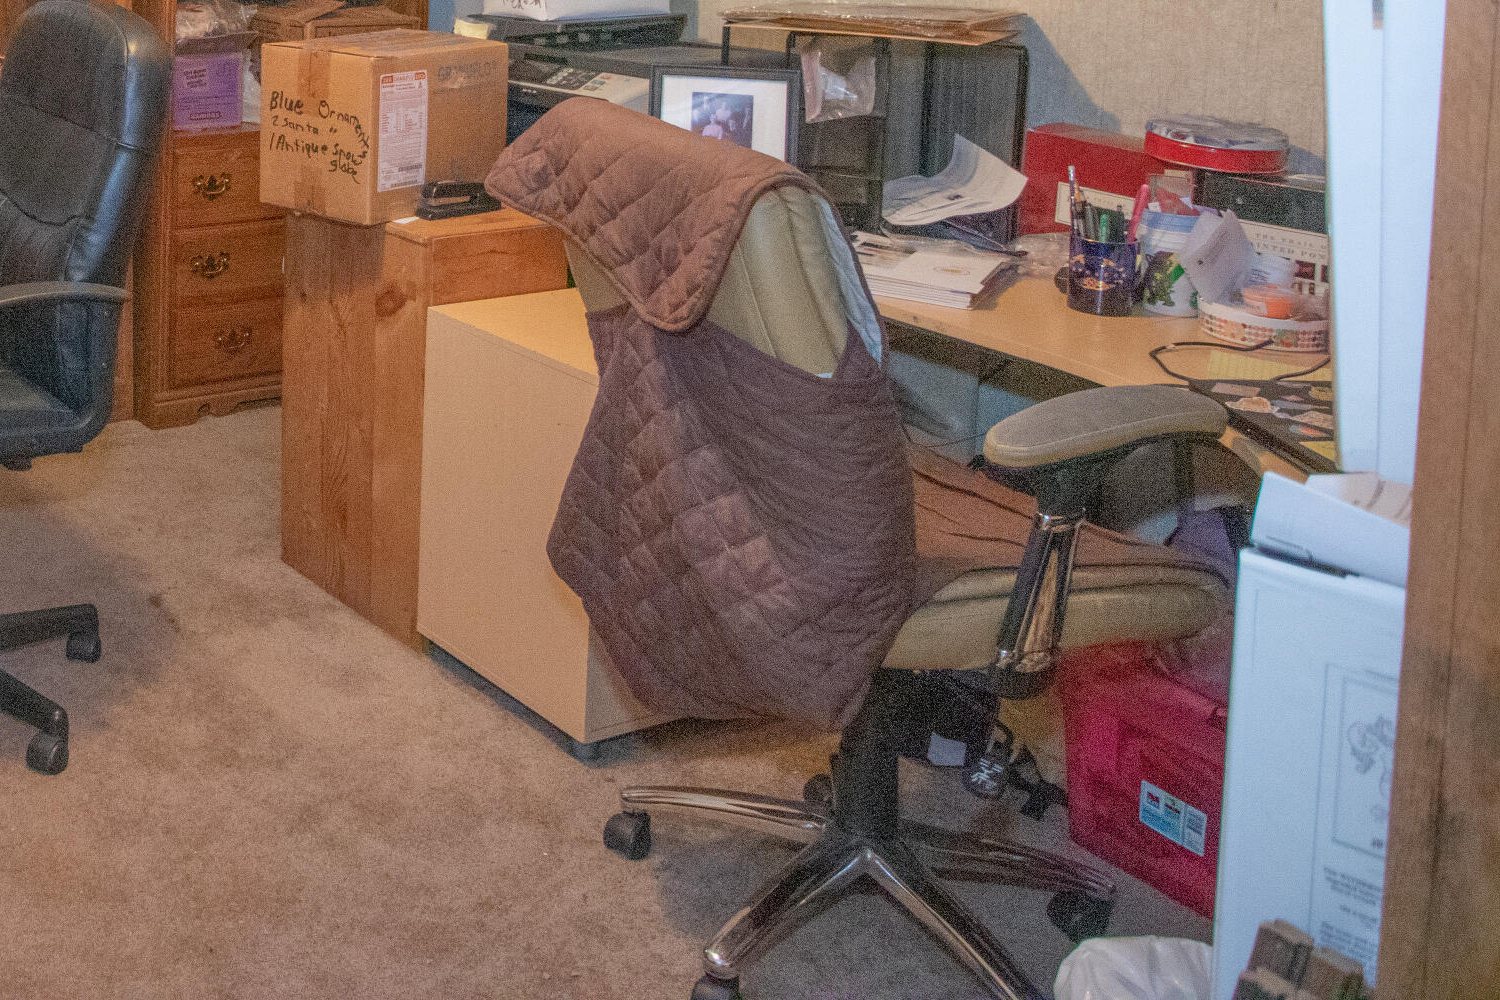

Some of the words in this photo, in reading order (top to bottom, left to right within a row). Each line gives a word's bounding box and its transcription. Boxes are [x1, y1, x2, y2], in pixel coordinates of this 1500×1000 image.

[269, 90, 304, 115] Blue
[272, 115, 279, 126] 2
[282, 117, 319, 135] Santa
[276, 134, 328, 158] Antique
